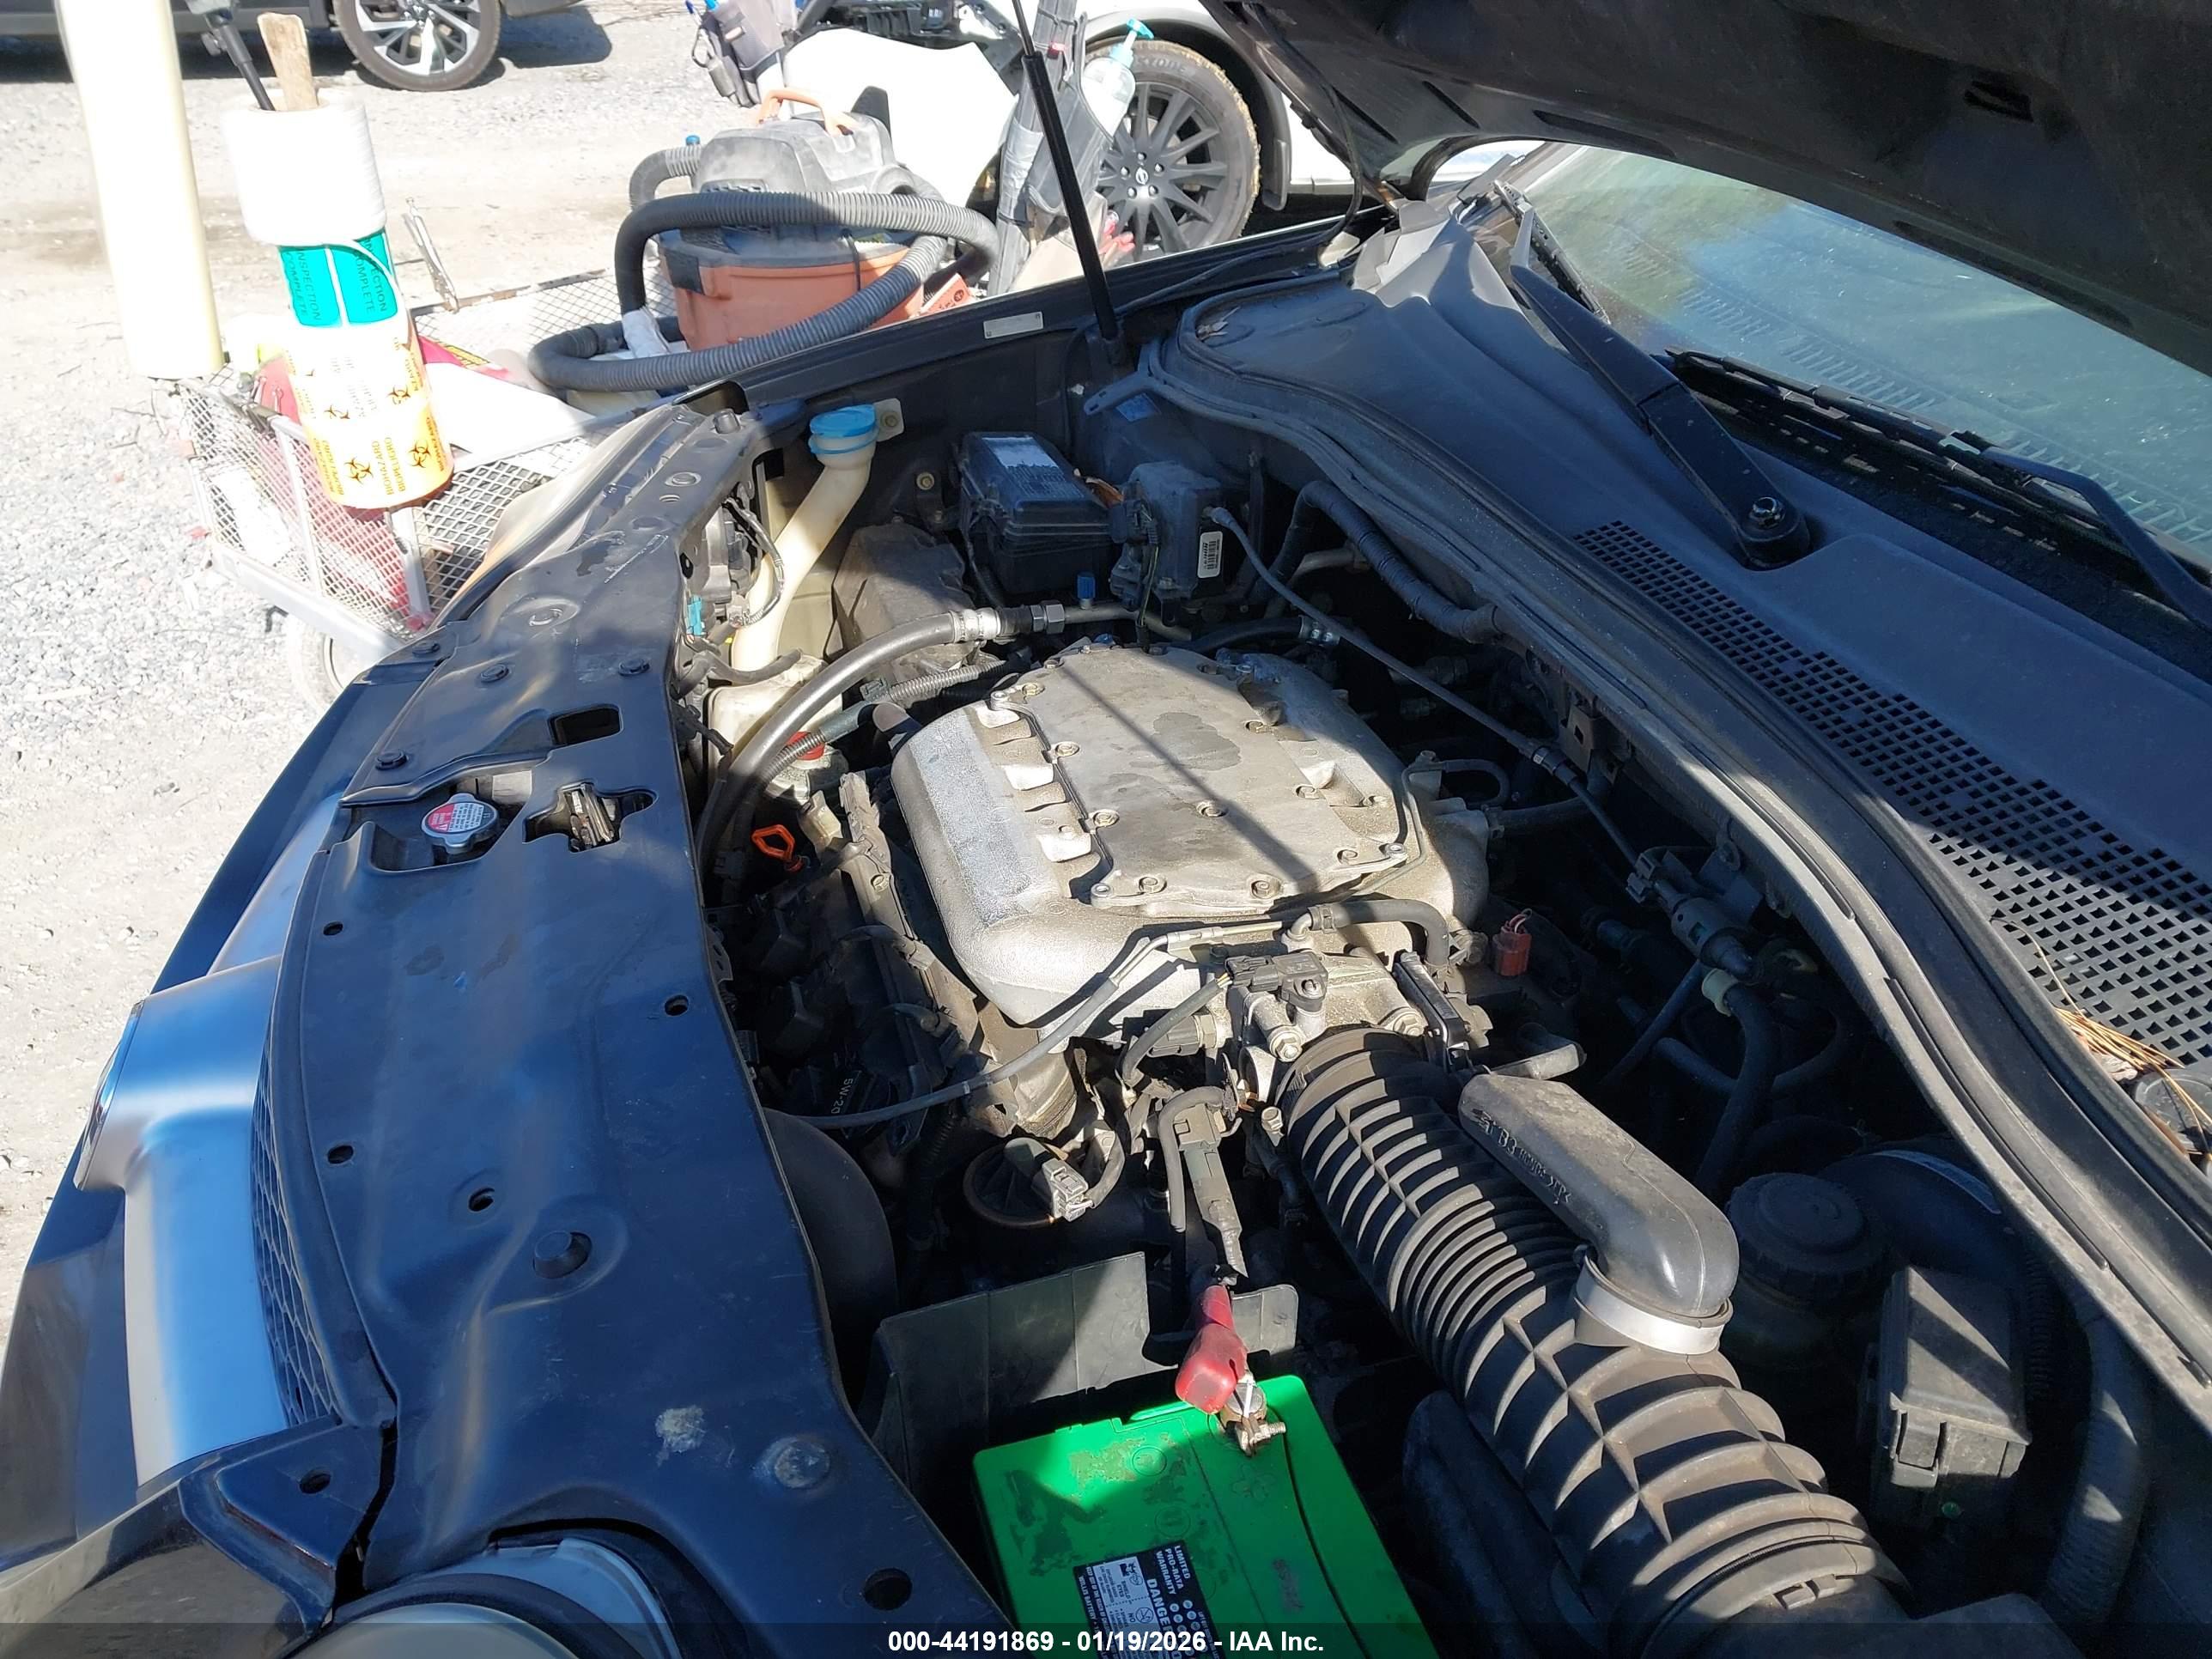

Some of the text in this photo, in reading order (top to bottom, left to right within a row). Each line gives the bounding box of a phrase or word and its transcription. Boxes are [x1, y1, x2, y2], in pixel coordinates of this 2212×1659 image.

[363, 239, 387, 313] INECTION
[372, 441, 395, 495] BIOHAZARD
[830, 1078, 854, 1114] 5W-20
[1155, 1551, 1176, 1595] WARRANTY
[1164, 1547, 1184, 1589] PRO-RATA
[1174, 1545, 1191, 1579] LIMITED
[1083, 1595, 1097, 1620] BATTERY
[1127, 1612, 1135, 1622] NO
